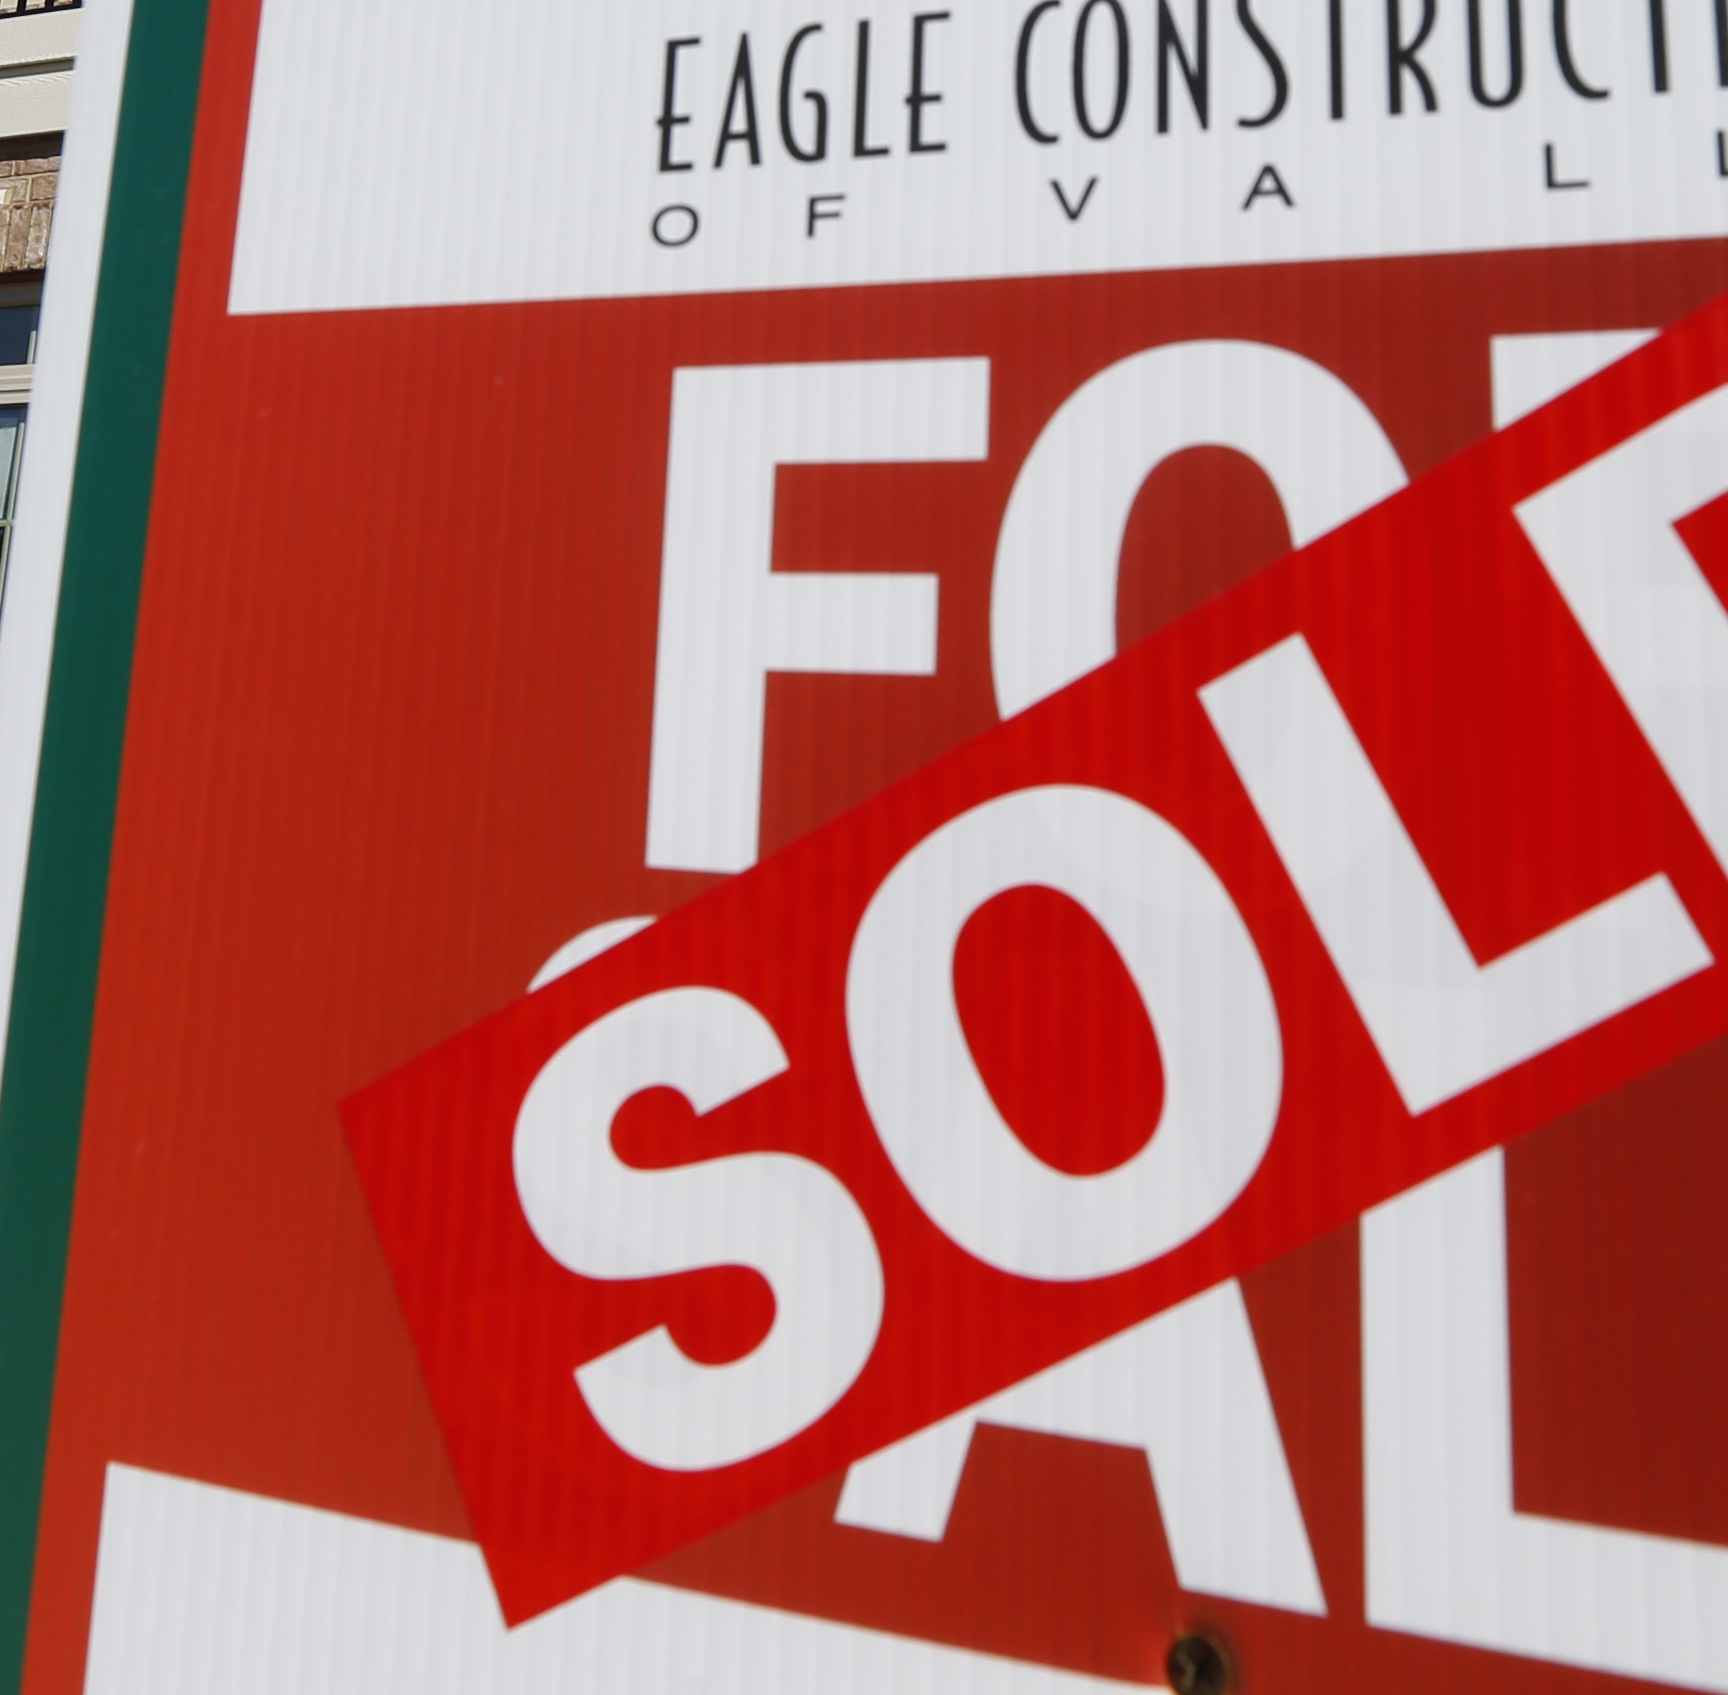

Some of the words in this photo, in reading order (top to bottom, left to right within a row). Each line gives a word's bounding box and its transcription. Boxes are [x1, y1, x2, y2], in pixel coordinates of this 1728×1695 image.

[655, 10, 951, 174] EAGLE
[650, 194, 845, 248] OF
[1050, 163, 1294, 222] VA
